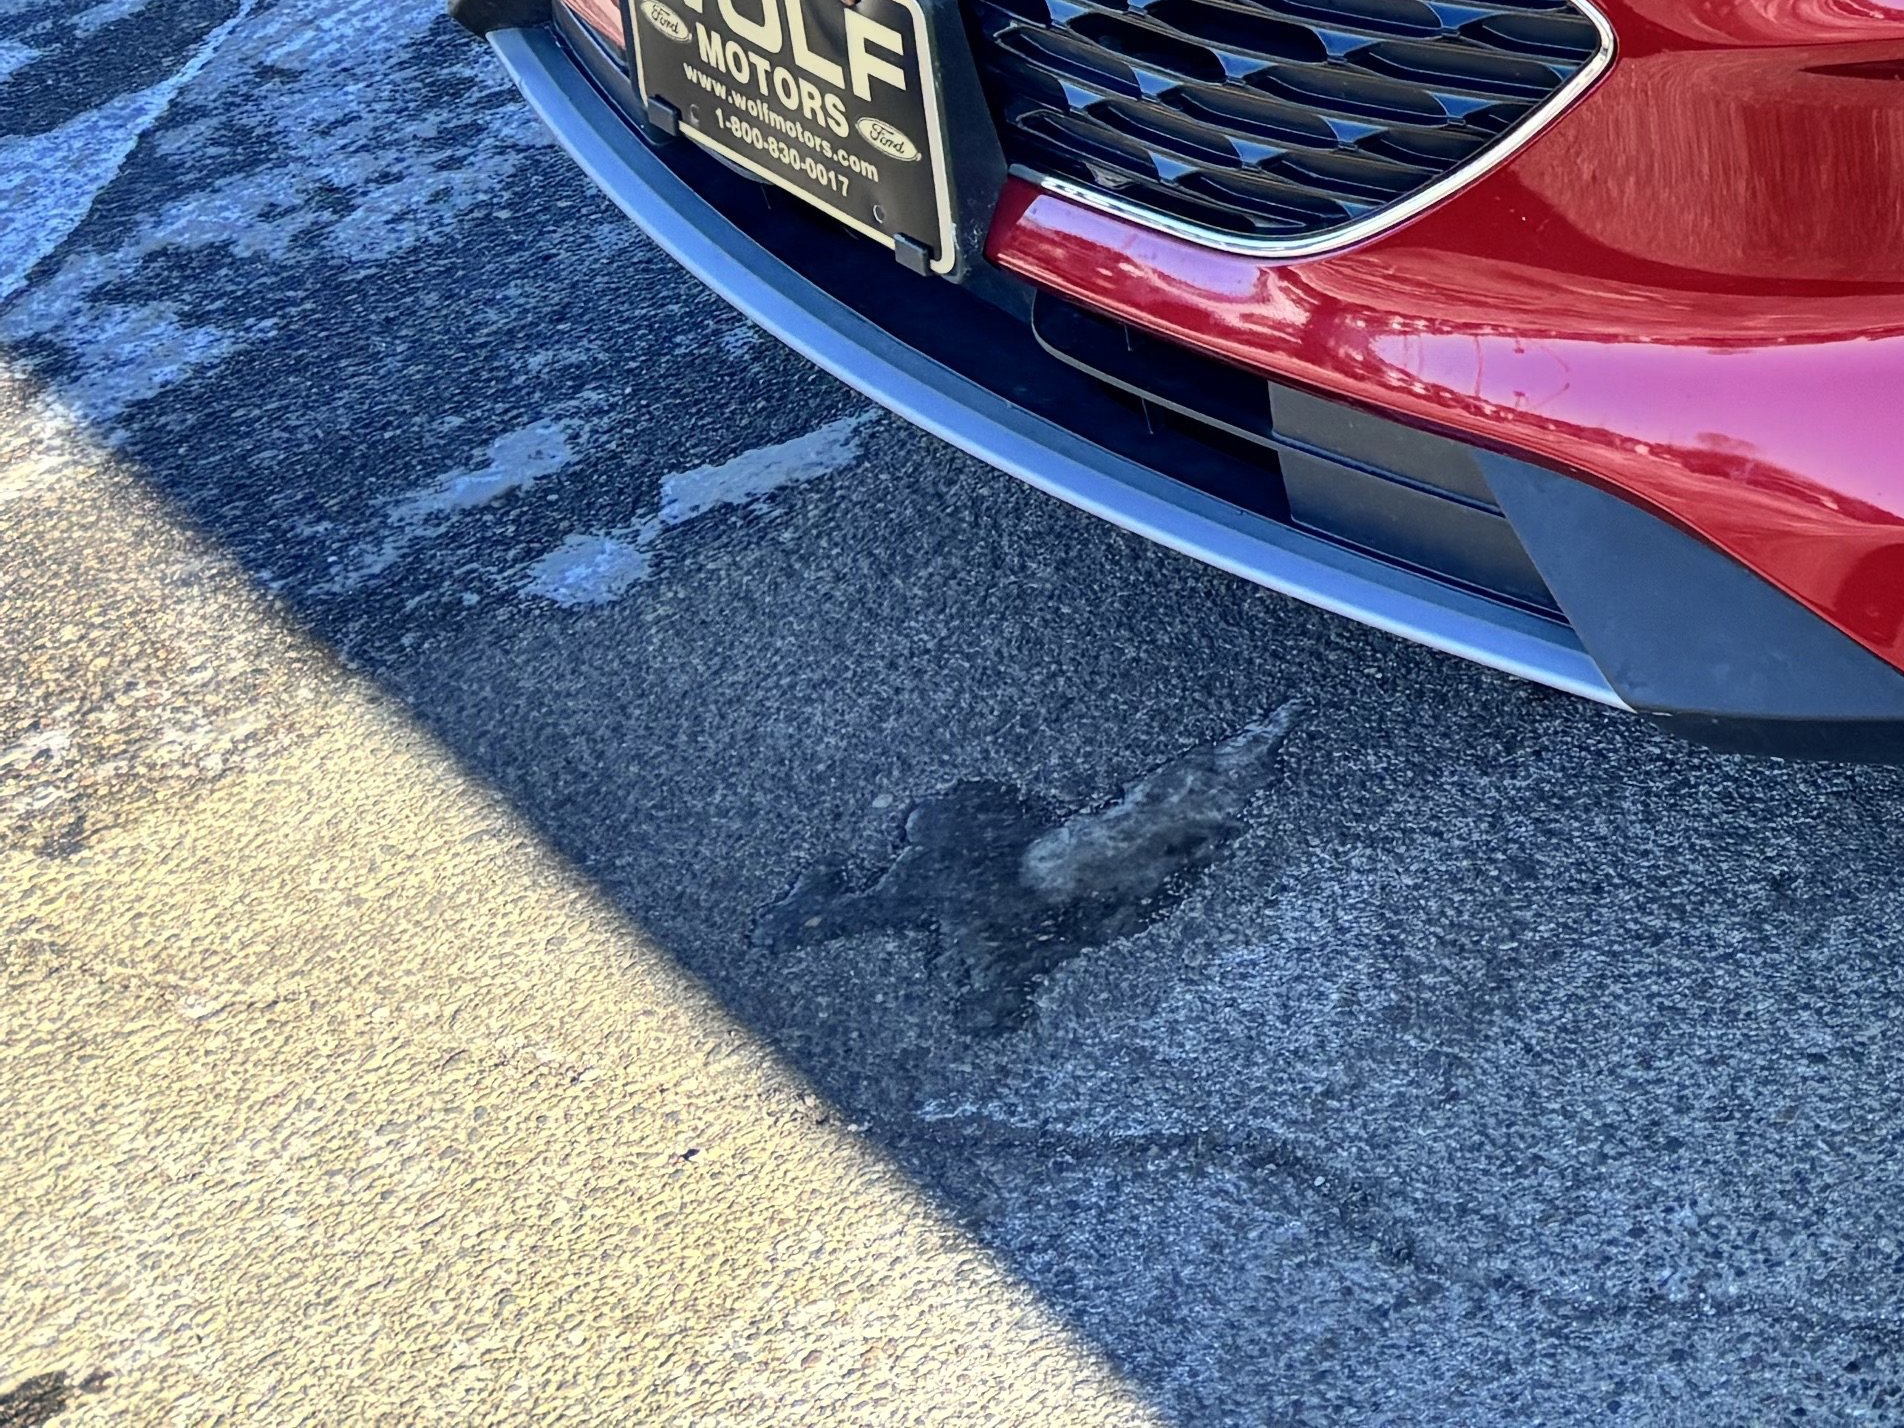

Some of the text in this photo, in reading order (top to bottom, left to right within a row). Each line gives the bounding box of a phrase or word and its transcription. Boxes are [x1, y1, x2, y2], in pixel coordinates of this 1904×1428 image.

[649, 2, 680, 37] Ford
[683, 60, 879, 183] www.wolfmotors.com
[695, 21, 851, 139] MOTORS
[714, 106, 851, 197] 1-800-830-0017
[868, 121, 907, 155] Ford
